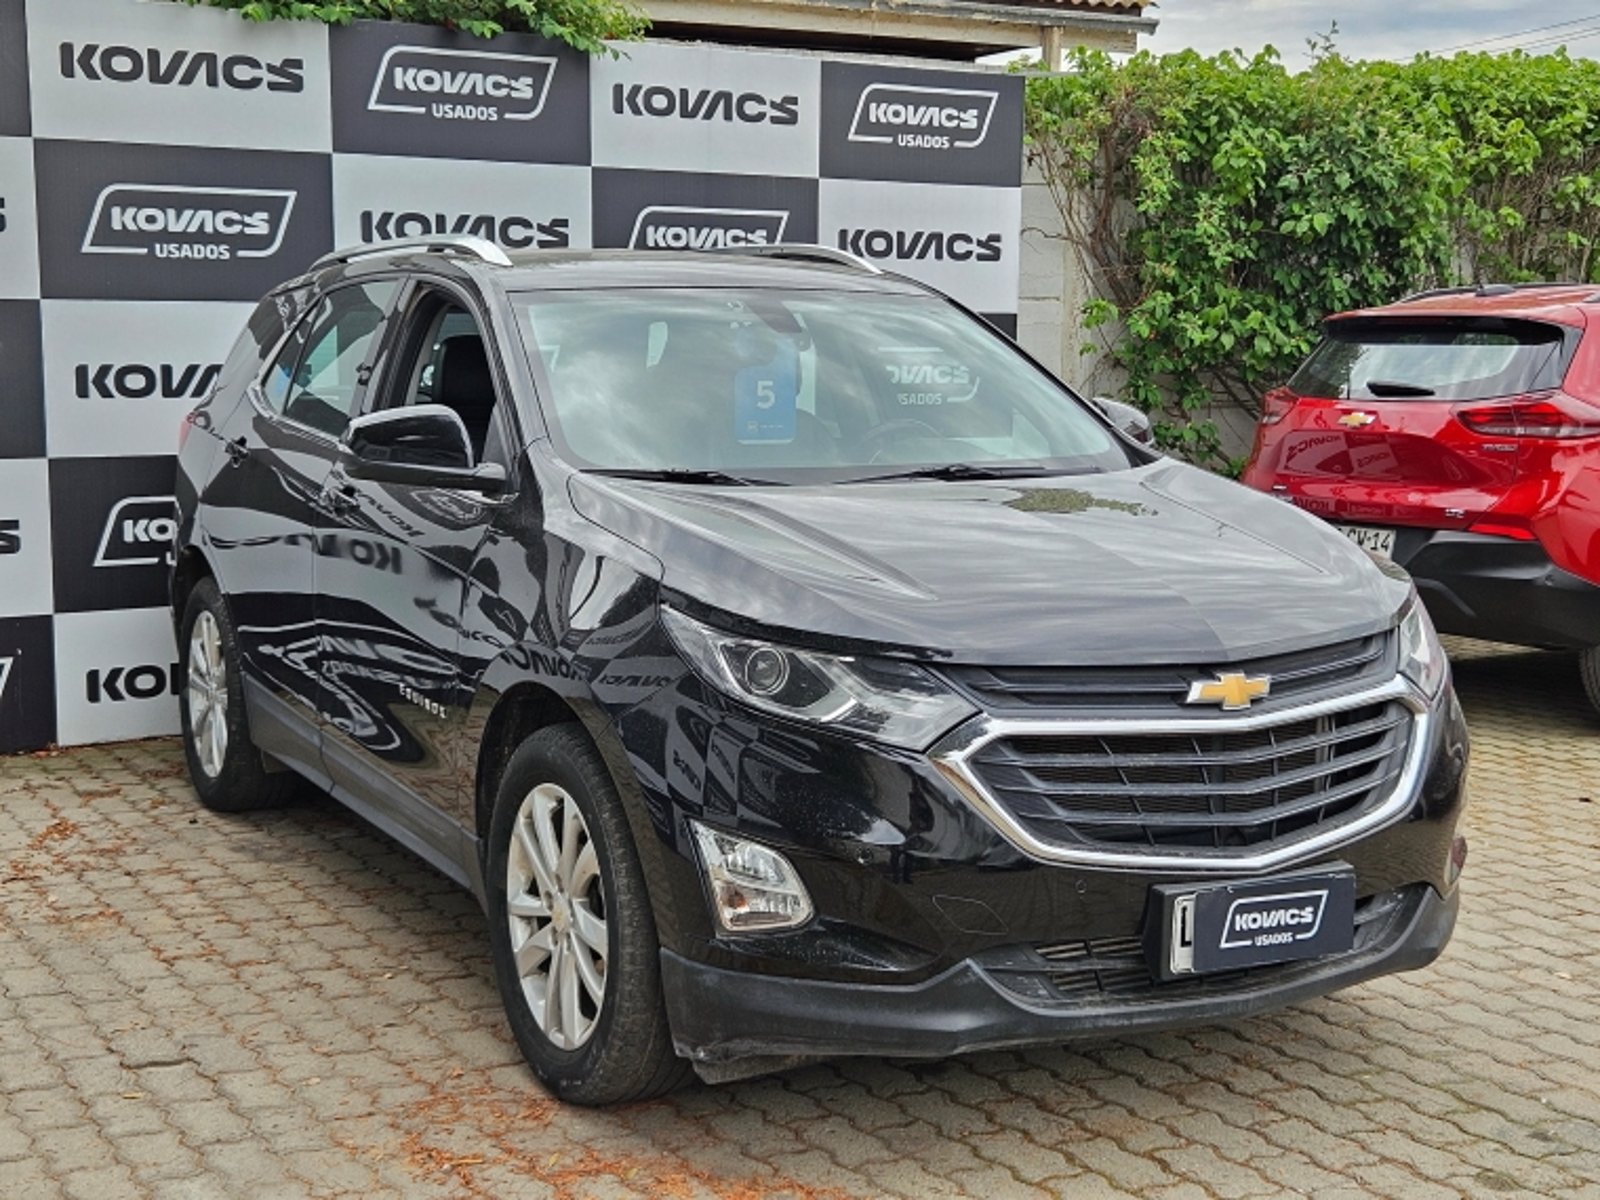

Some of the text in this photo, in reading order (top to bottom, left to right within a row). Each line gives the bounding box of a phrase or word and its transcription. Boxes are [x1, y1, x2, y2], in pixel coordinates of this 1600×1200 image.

[59, 41, 304, 93] KOVACS
[394, 66, 535, 99] KOVACS
[431, 102, 498, 121] USADOS
[612, 83, 799, 125] KOVACS
[868, 102, 979, 130] KOVACS
[897, 133, 951, 149] USADOS
[110, 206, 270, 236] KOVACS
[360, 210, 569, 249] KOVACS
[154, 242, 231, 260] USADOS
[645, 225, 768, 249] KOVACS
[838, 228, 1003, 262] KOVACS
[757, 380, 775, 409] 5
[897, 393, 942, 405] SADOS
[1235, 906, 1314, 932] KOVACS
[1254, 932, 1294, 946] USADOS
